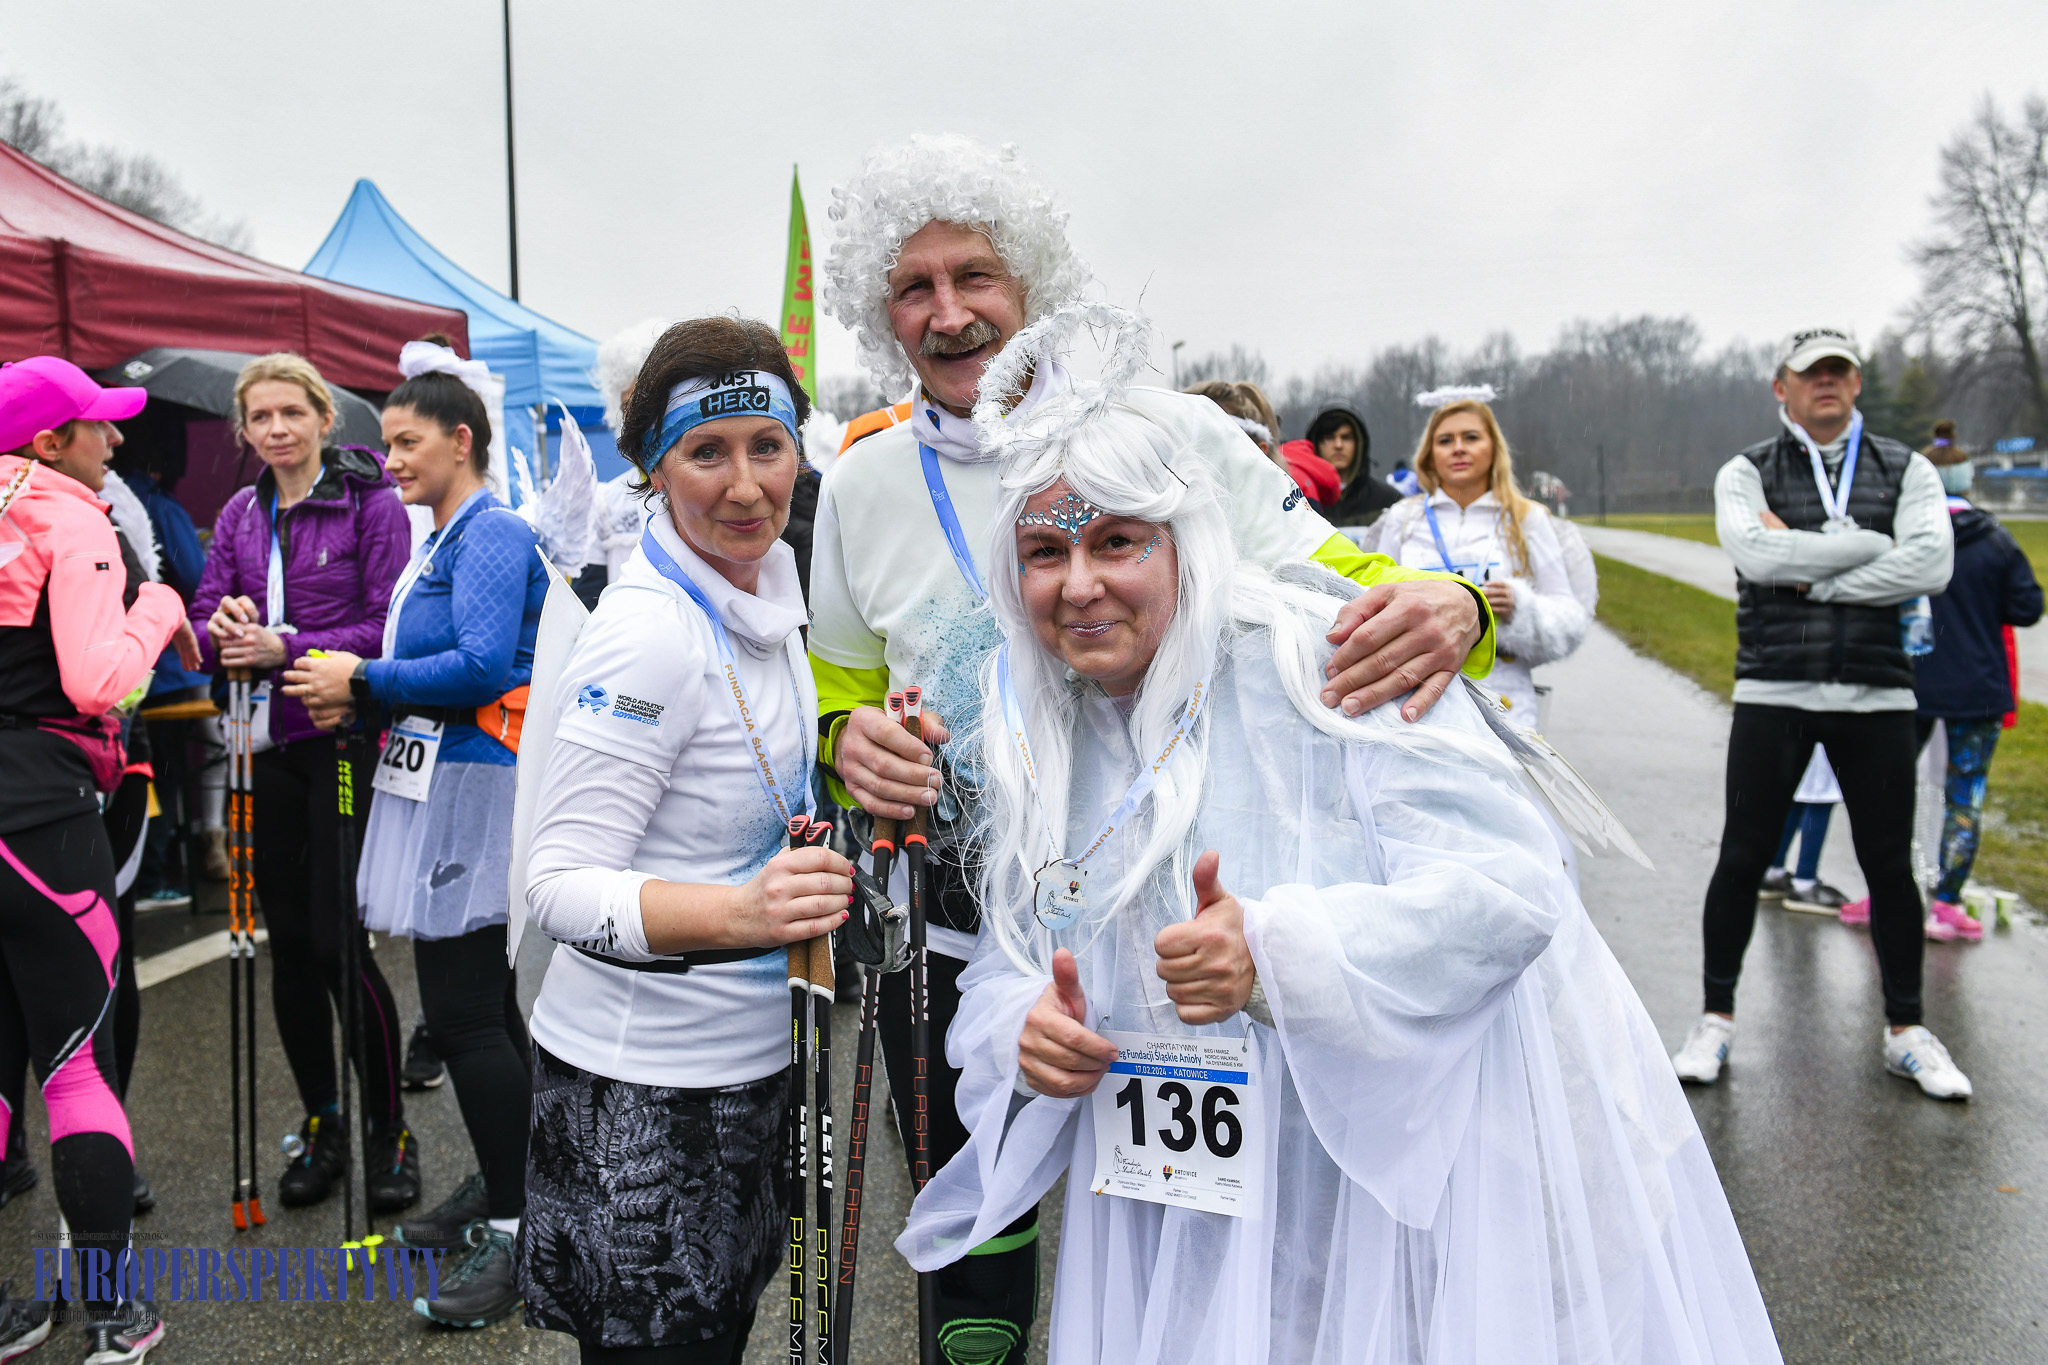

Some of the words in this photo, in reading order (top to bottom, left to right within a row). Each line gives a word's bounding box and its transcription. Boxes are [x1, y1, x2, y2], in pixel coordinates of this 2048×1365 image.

[709, 371, 759, 389] JUST
[707, 391, 767, 413] HERO
[614, 704, 658, 720] CHAMPIONSHIPS
[615, 699, 631, 708] HALF
[630, 703, 661, 716] MARATHON
[616, 694, 638, 703] WORLD
[638, 699, 665, 711] ATHLETICS
[612, 710, 641, 722] GDYNIA
[641, 717, 659, 726] 2020
[382, 734, 425, 772] 220
[725, 664, 755, 732] FUNDACJA
[772, 793, 790, 822] ANIO
[1146, 1042, 1198, 1052] CHARYTATYWNY
[1126, 1048, 1153, 1062] Fundacji
[1154, 1048, 1179, 1063] Śląskie
[1180, 1053, 1202, 1067] Anioły
[1135, 1065, 1167, 1076] 17.02.2024
[1173, 1069, 1209, 1080] KATOWICE
[850, 1063, 872, 1159] FLASH
[914, 1056, 929, 1152] FLASH
[1116, 1077, 1243, 1158] 136
[822, 1114, 833, 1189] LEKI
[839, 1168, 863, 1285] CARBON
